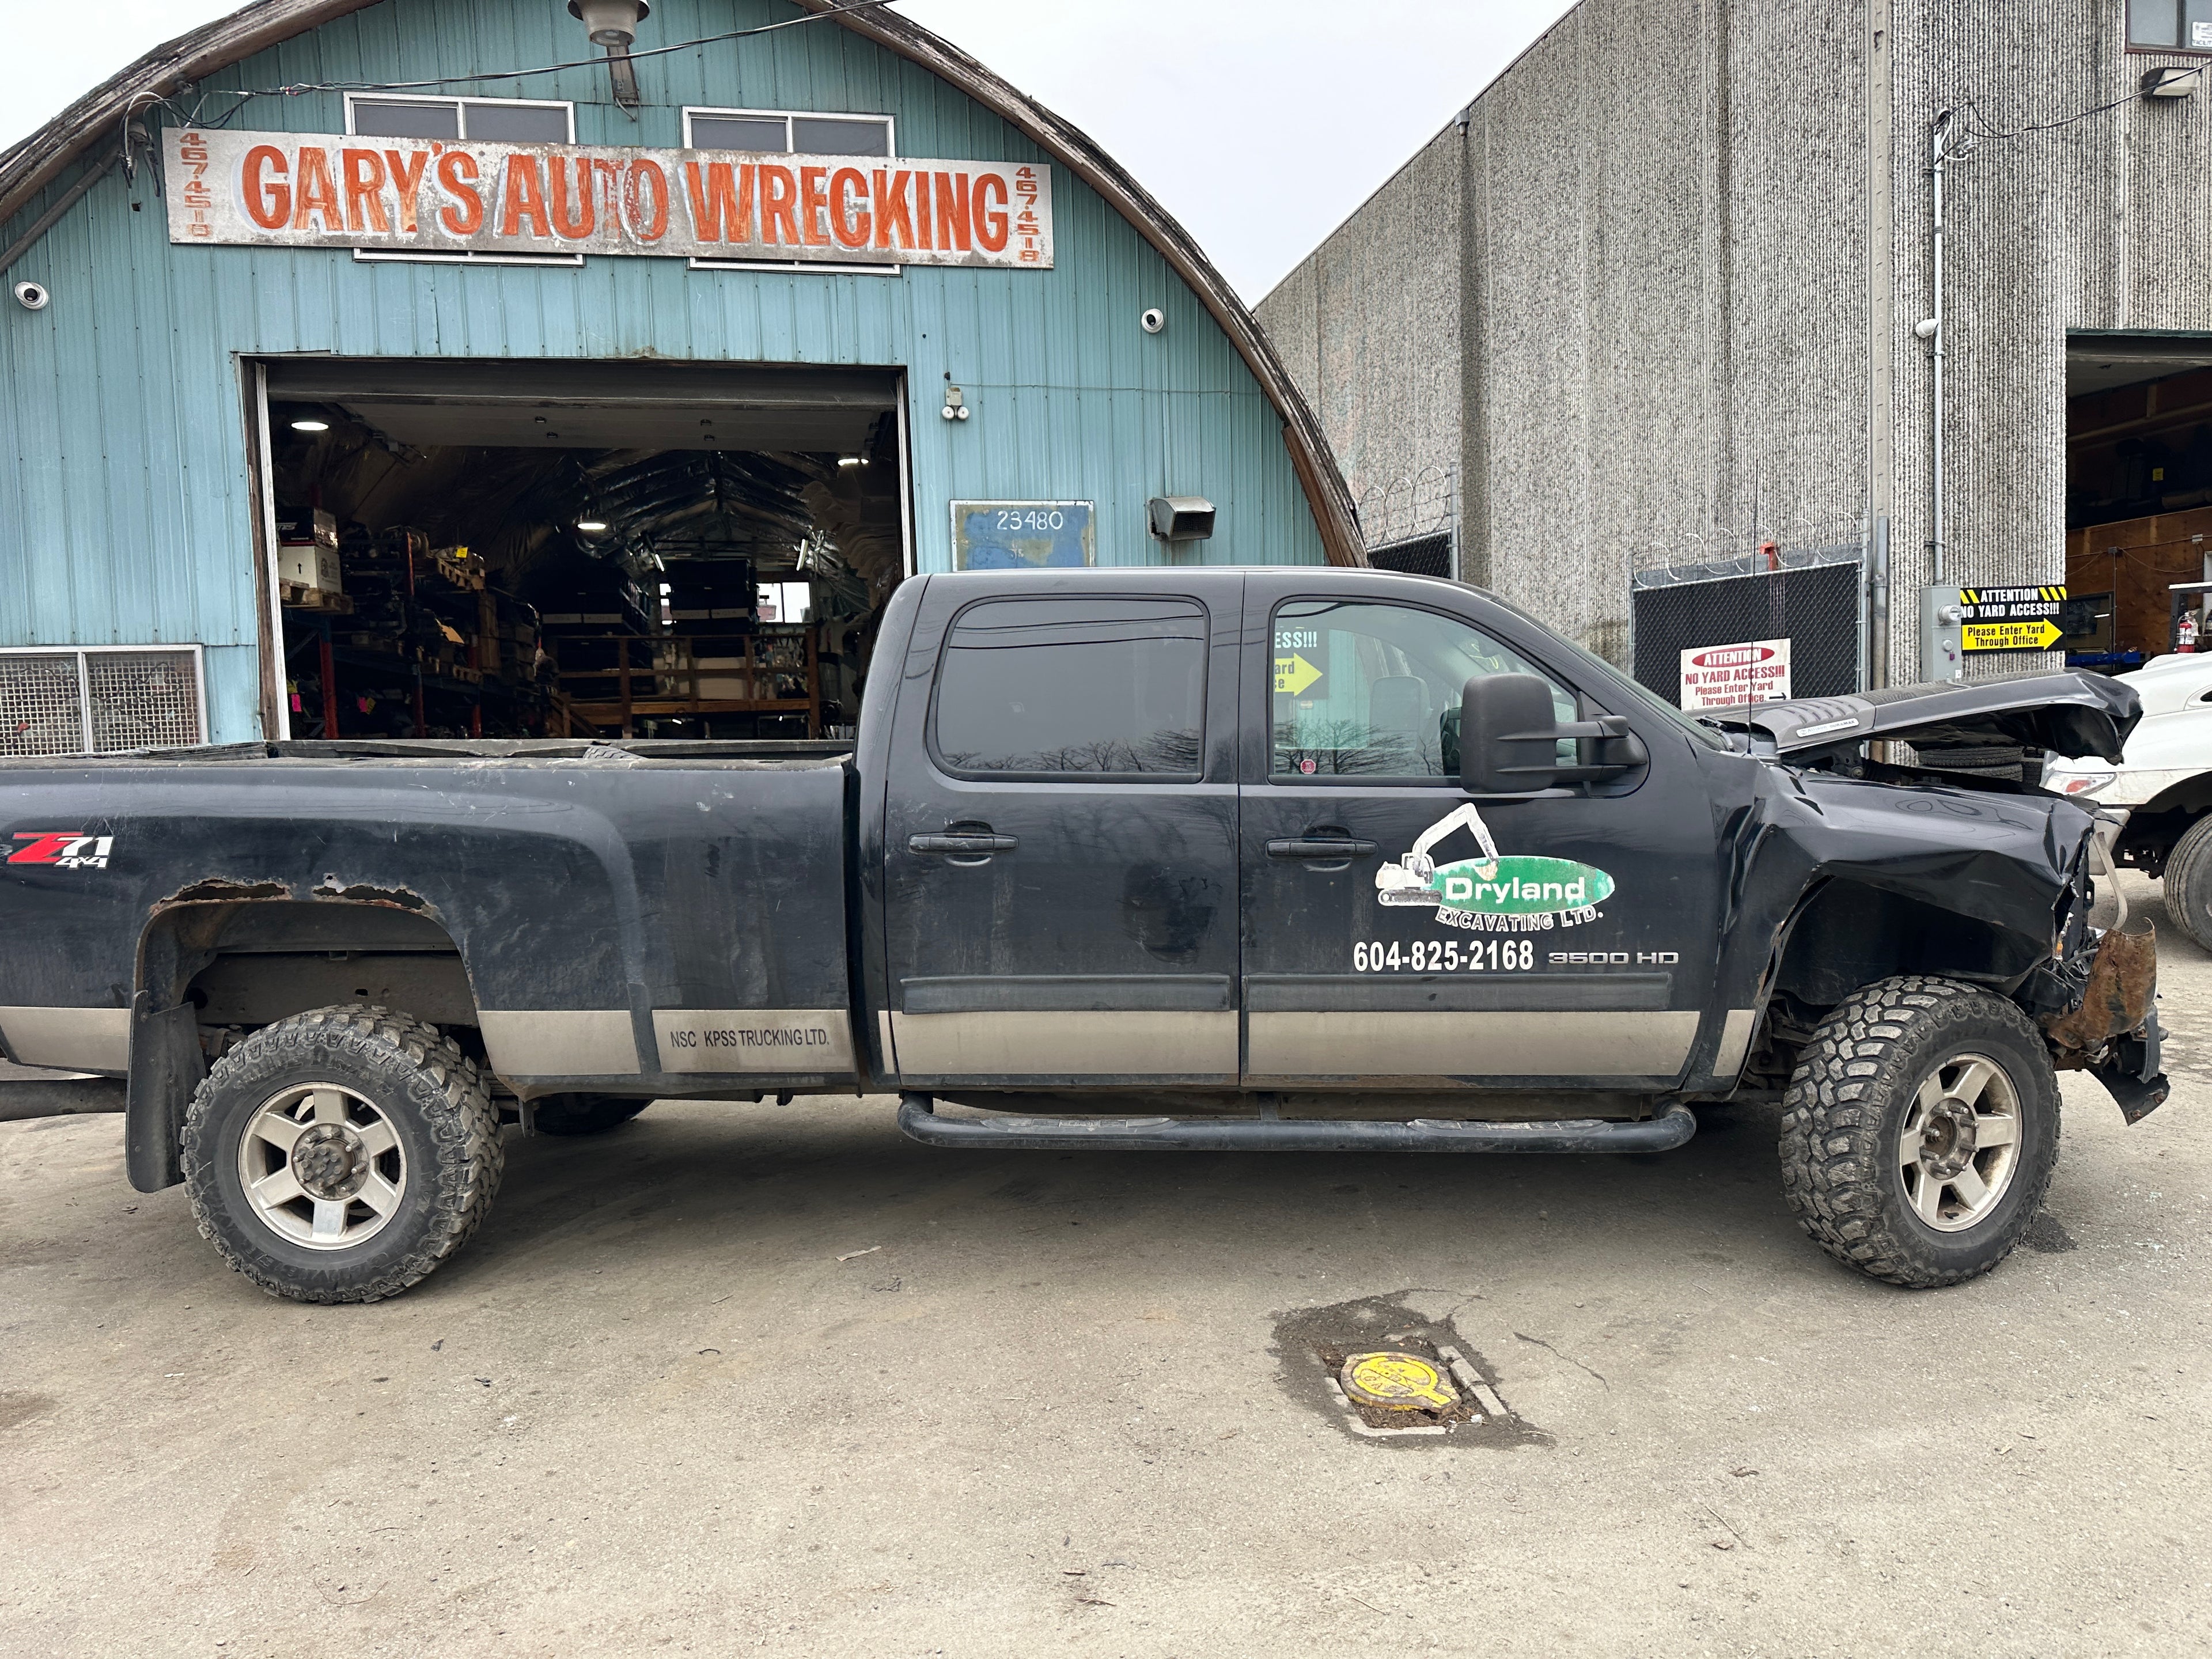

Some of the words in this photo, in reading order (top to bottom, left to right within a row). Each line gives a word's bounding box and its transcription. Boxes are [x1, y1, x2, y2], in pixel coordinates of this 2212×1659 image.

[241, 142, 484, 235] GARY'S
[502, 153, 669, 242] AUTO
[684, 160, 1010, 253] WRECKING
[997, 510, 1063, 531] 23480
[1980, 588, 2038, 603] ATTENTION
[1961, 605, 1974, 618] NO
[1978, 605, 2006, 618] YARD
[2010, 603, 2059, 616] ACCESS!!!
[1968, 627, 1995, 637] Please
[1999, 626, 2022, 635] Enter
[2027, 624, 2045, 634] Yard
[1975, 637, 2009, 647] Through
[2013, 636, 2039, 645] Office
[1704, 648, 1762, 666] ATTENTION
[1685, 673, 1699, 685] NO
[1702, 670, 1730, 684] YARD
[1733, 665, 1785, 681] ACCESS!!!
[1695, 686, 1722, 695] Please
[1724, 684, 1748, 692] Enter
[1751, 681, 1773, 691] Yard
[1702, 695, 1736, 706] Through
[7, 831, 113, 863] Z71
[1445, 876, 1585, 903] Dryland
[1435, 907, 1554, 932] EXCAVATING
[1561, 904, 1604, 928] LTD.
[1353, 940, 1534, 971] 604-825-2168
[1548, 952, 1629, 965] 3500
[1637, 952, 1679, 965] HD
[670, 1031, 696, 1048] NSC
[704, 1030, 737, 1047] KPSS
[738, 1028, 802, 1047] TRUCKING
[806, 1028, 830, 1045] LTD.
